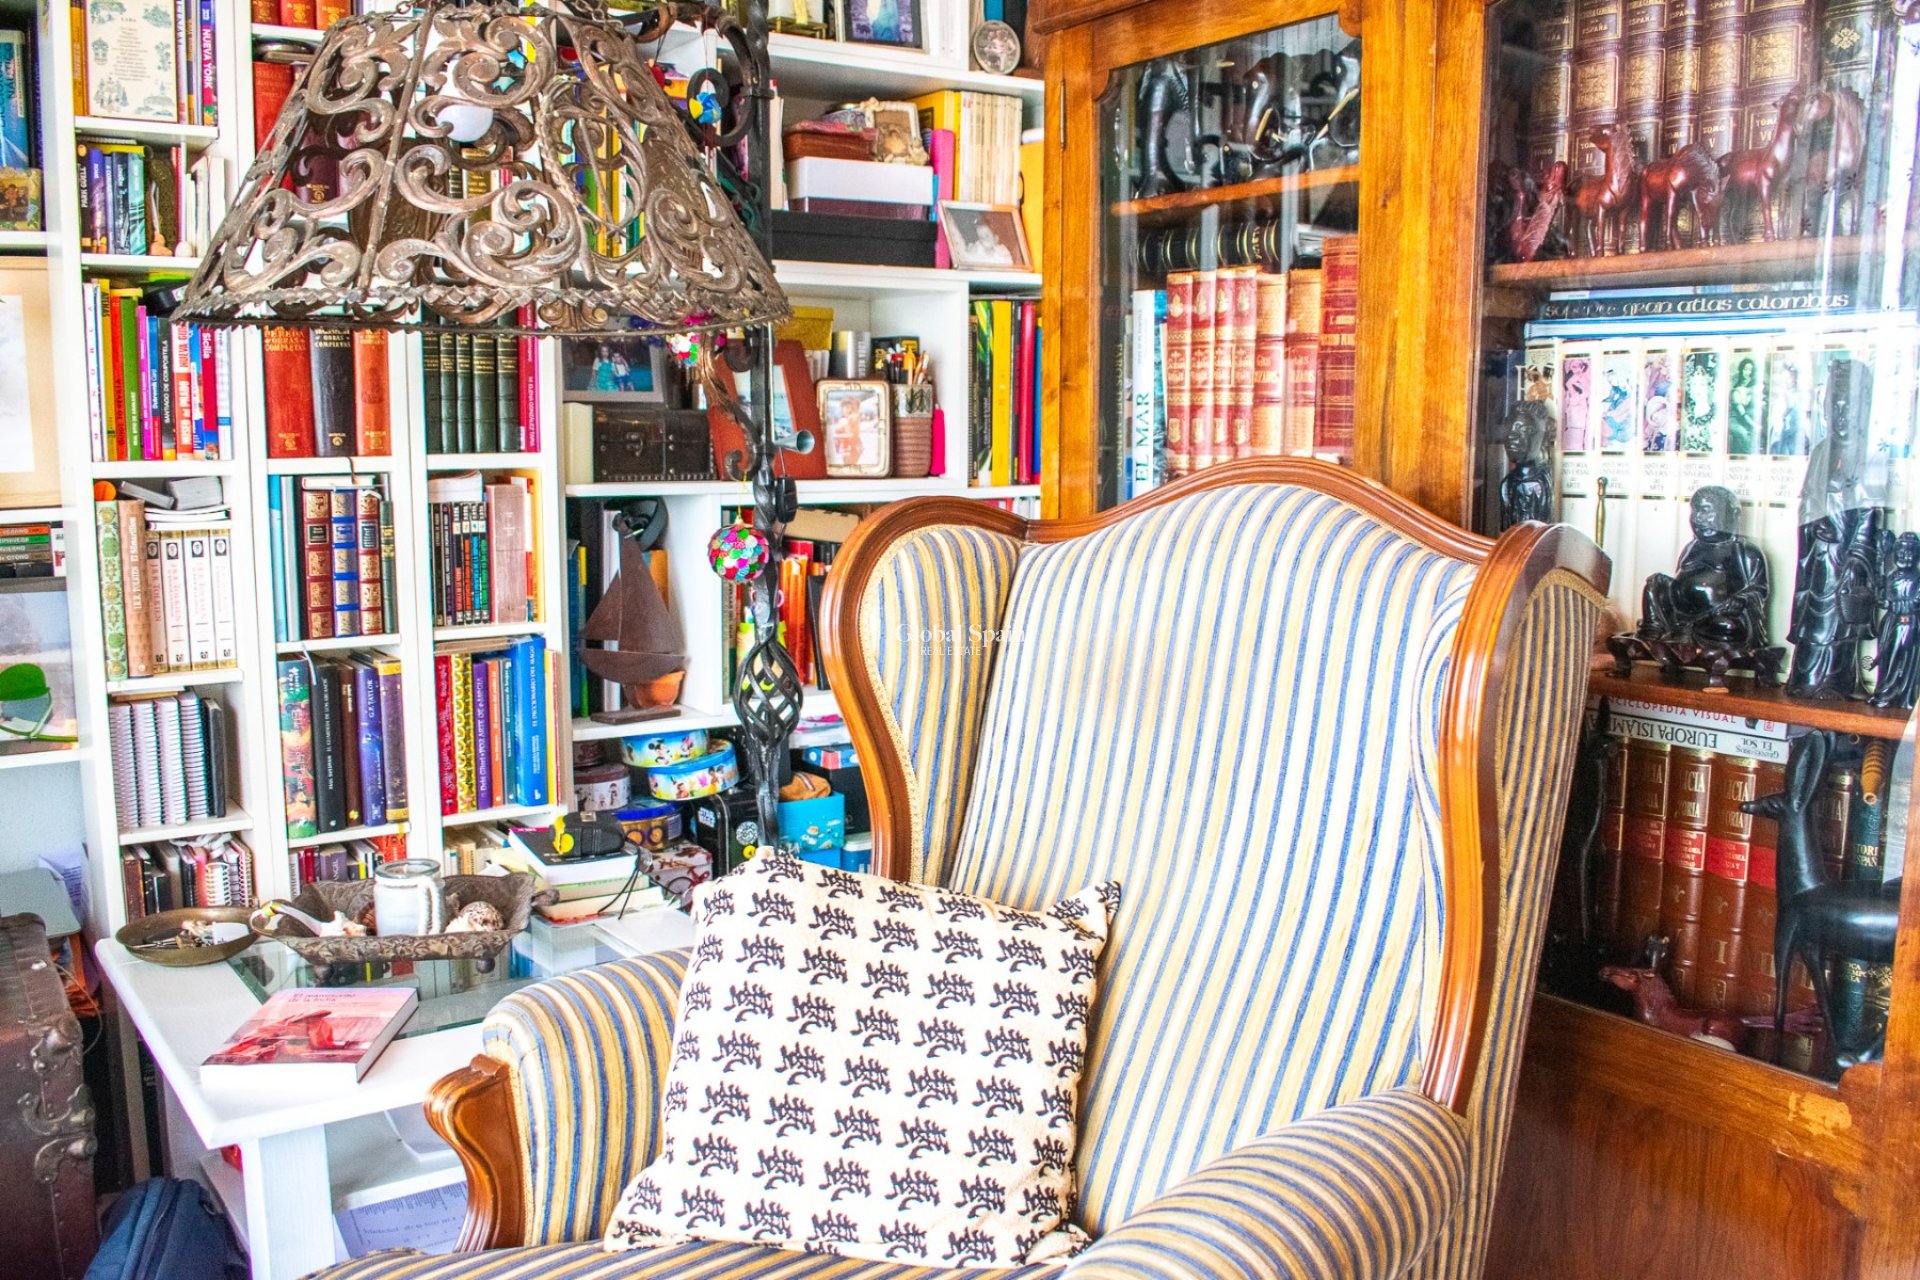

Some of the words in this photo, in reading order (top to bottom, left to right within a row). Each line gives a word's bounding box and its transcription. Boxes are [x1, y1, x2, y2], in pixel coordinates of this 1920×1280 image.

[202, 29, 211, 60] NUEVA
[203, 63, 212, 89] YORK
[1677, 298, 1732, 312] atlas
[179, 344, 189, 367] NUEVA
[202, 332, 211, 359] Sicilia
[163, 384, 169, 392] DE
[179, 380, 190, 407] PRADO
[1136, 393, 1149, 446] MAR
[180, 420, 191, 445] MUSEO
[1136, 455, 1149, 481] EL
[366, 680, 374, 704] TAYLOR
[1693, 708, 1737, 725] VISUAL
[1658, 725, 1718, 749] EUROPA
[1741, 738, 1757, 747] SOL
[1761, 741, 1772, 751] EL
